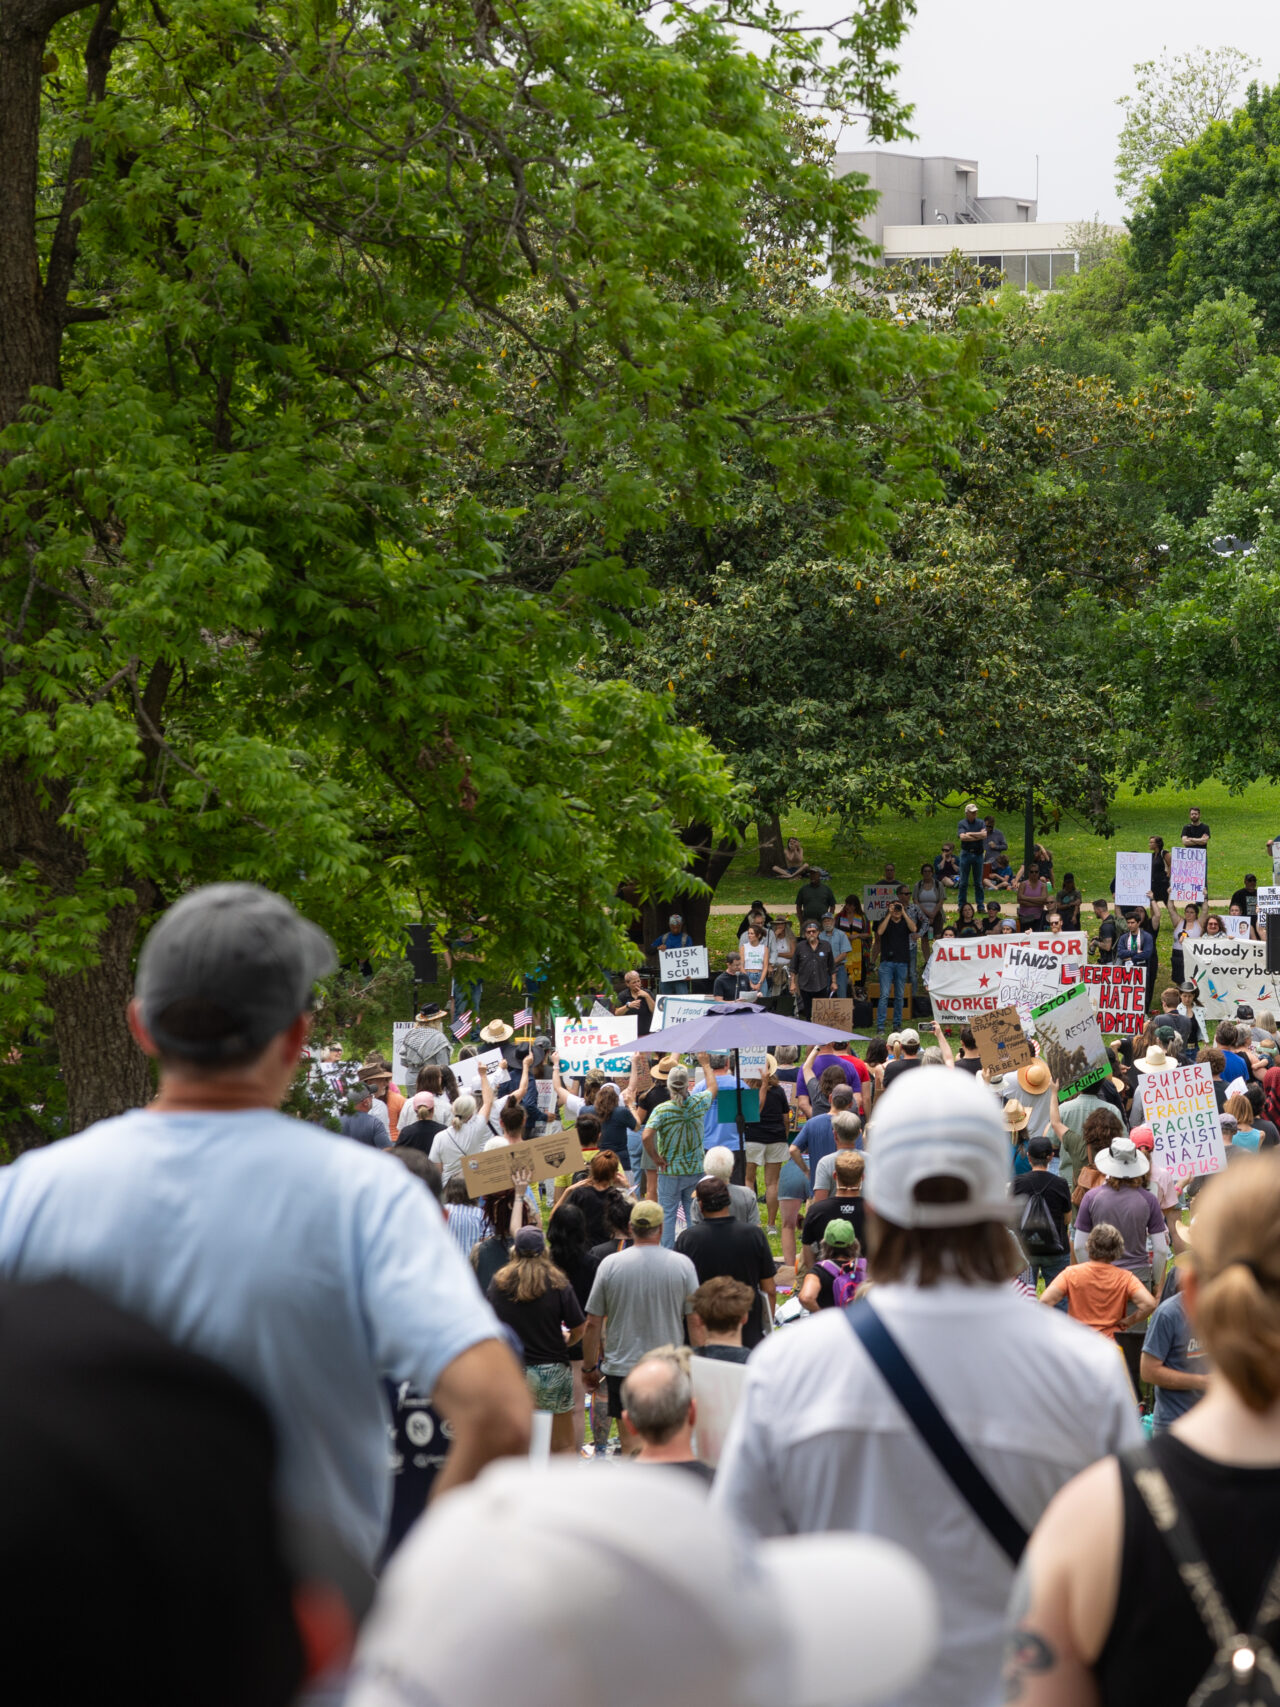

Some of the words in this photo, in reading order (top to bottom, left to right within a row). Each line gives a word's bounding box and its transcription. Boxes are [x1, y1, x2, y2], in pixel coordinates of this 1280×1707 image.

[1188, 849, 1205, 861] ONLY
[1173, 883, 1186, 892] ARE
[1191, 883, 1203, 892] THE
[1176, 891, 1198, 901] RICH
[1267, 887, 1277, 895] THE
[1259, 914, 1266, 923] IS
[665, 948, 698, 960] MUSK
[935, 947, 971, 962] ALL
[1009, 948, 1058, 970] HANDS
[1192, 943, 1250, 960] Nobody
[1253, 944, 1264, 958] is
[676, 959, 689, 968] IS
[667, 967, 699, 979] SCUM
[815, 1000, 841, 1012] DUE
[1037, 988, 1078, 1017] STOP
[1099, 984, 1145, 1011] HATE
[682, 1006, 703, 1016] stand
[974, 1008, 1013, 1024] STAND
[1064, 1014, 1096, 1040] RESIST
[1096, 1011, 1145, 1035] ADMIN
[563, 1034, 621, 1047] PEOPLE
[559, 1058, 591, 1075] DUE
[988, 1058, 1020, 1074] REBEL
[1064, 1067, 1105, 1097] TRUMP
[1147, 1066, 1204, 1089] SUPER
[1143, 1080, 1214, 1105] CALLOUS
[1145, 1094, 1216, 1121] FRAGILE
[1152, 1111, 1214, 1137] RACIST
[1154, 1126, 1217, 1152] SEXIST
[1165, 1142, 1213, 1166] NAZI
[1166, 1156, 1220, 1177] POTUS
